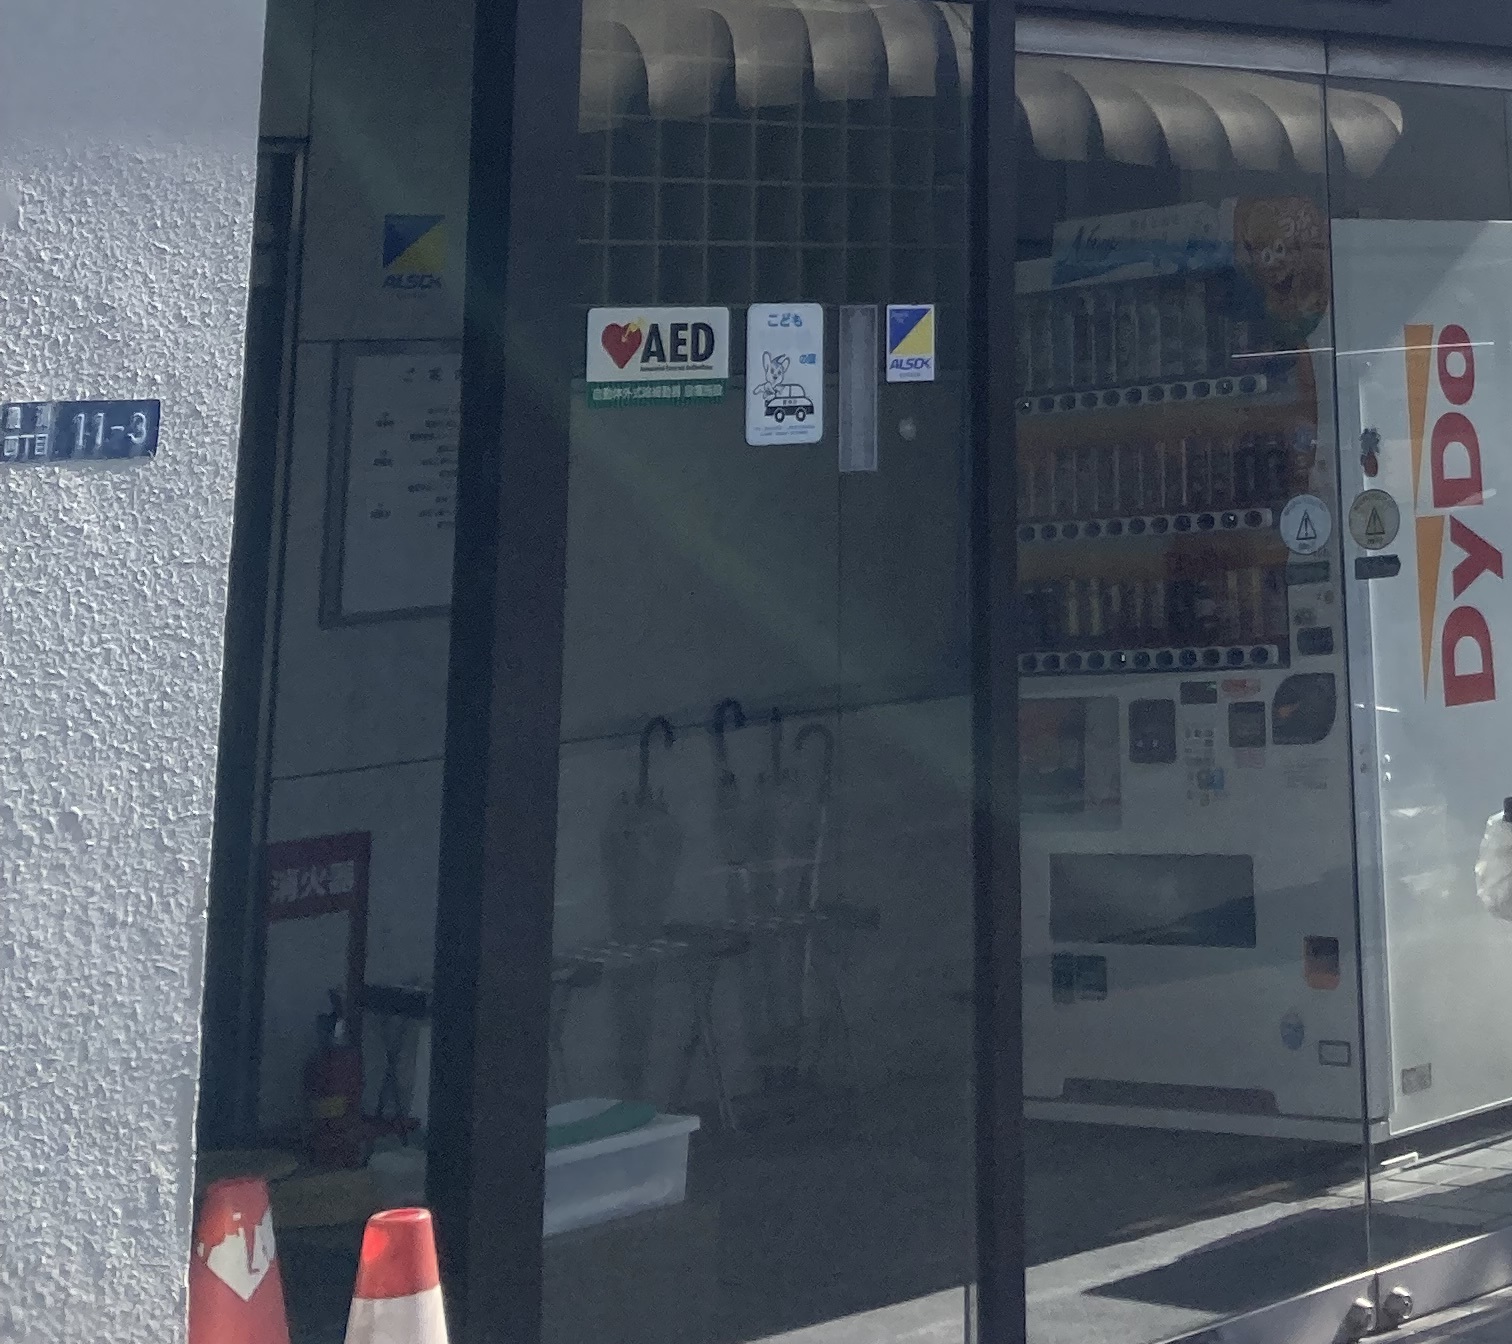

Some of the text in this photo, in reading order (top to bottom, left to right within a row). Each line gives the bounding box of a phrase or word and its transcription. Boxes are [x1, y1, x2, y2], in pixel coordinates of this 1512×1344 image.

[767, 312, 803, 327] こども
[640, 322, 715, 363] AED
[889, 357, 932, 371] ALSOK
[73, 412, 148, 446] 11-3
